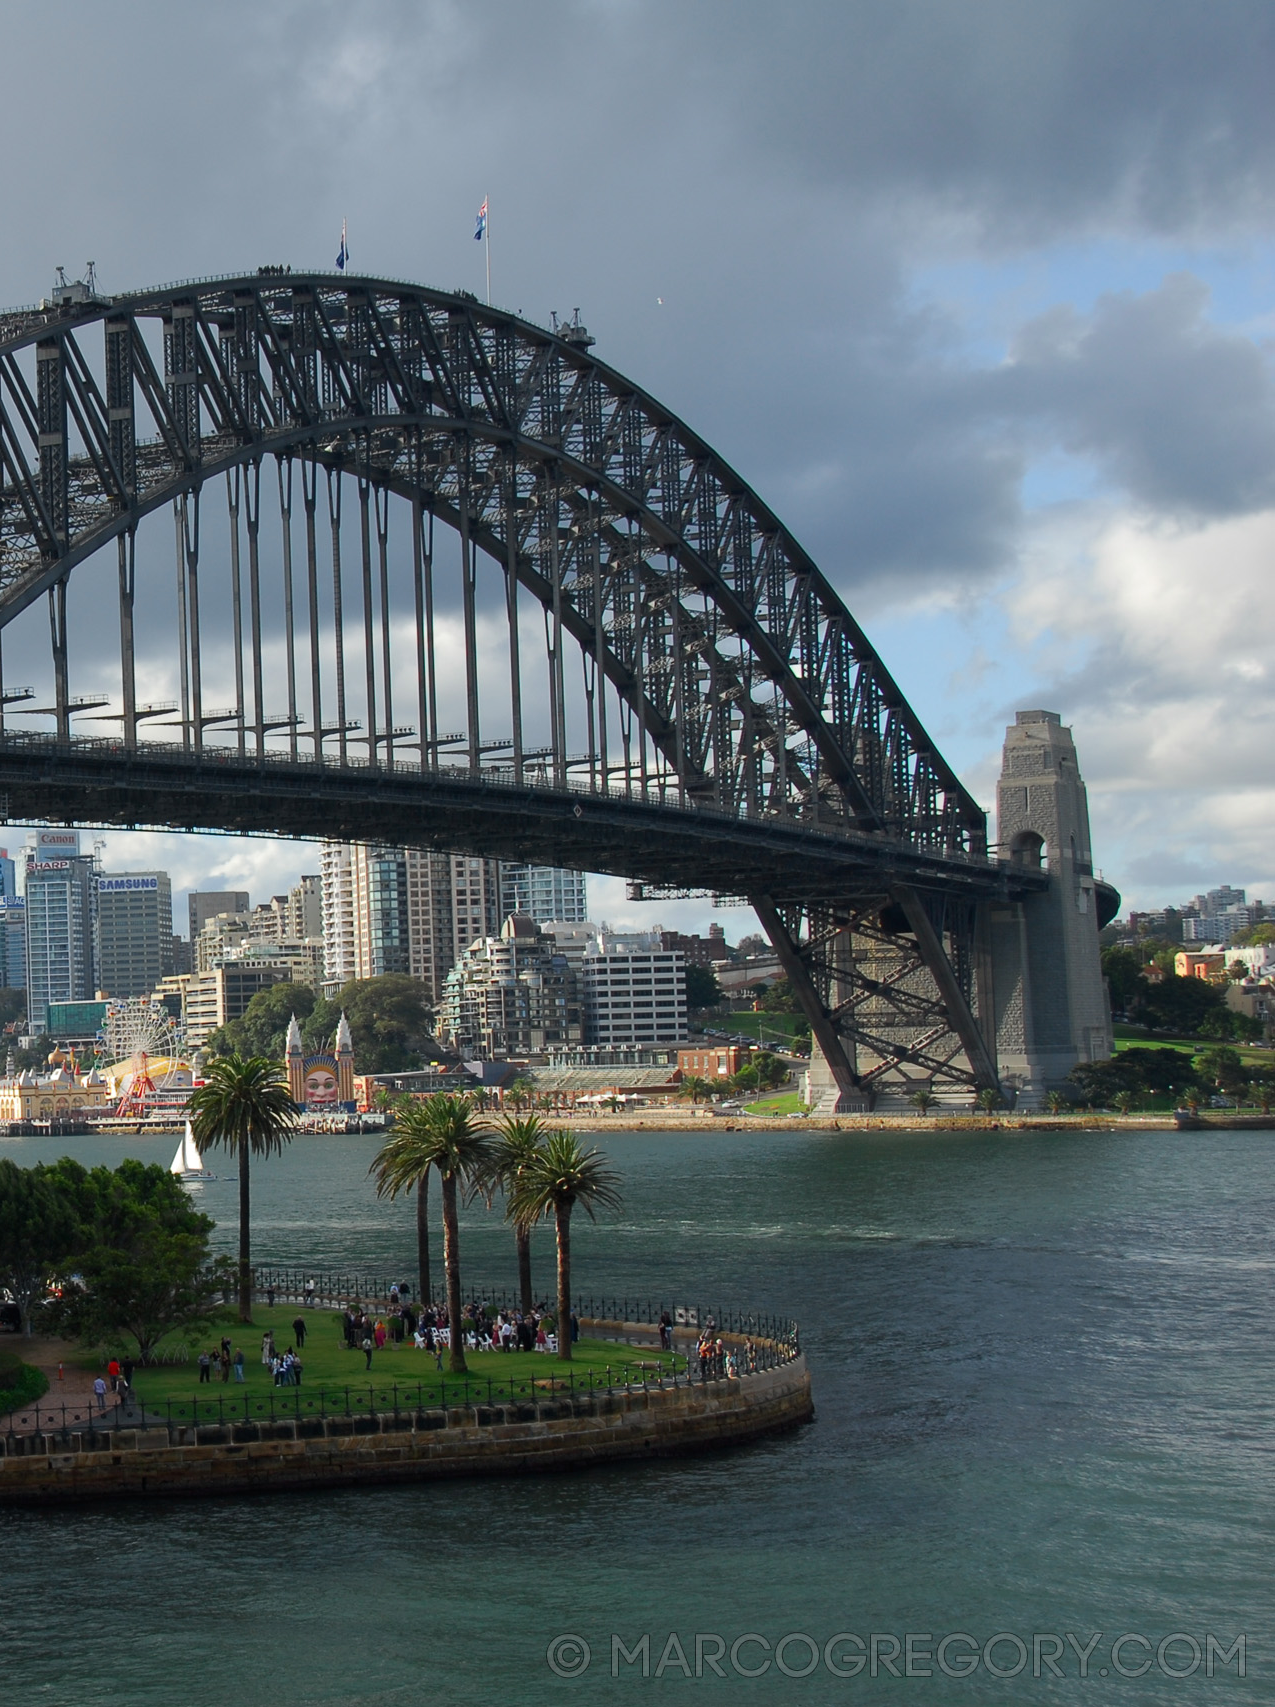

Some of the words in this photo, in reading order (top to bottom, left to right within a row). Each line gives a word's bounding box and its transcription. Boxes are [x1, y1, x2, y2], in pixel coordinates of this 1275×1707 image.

[41, 834, 75, 844] Canon
[26, 861, 68, 870] SHARP
[99, 878, 158, 890] SAMSUNG
